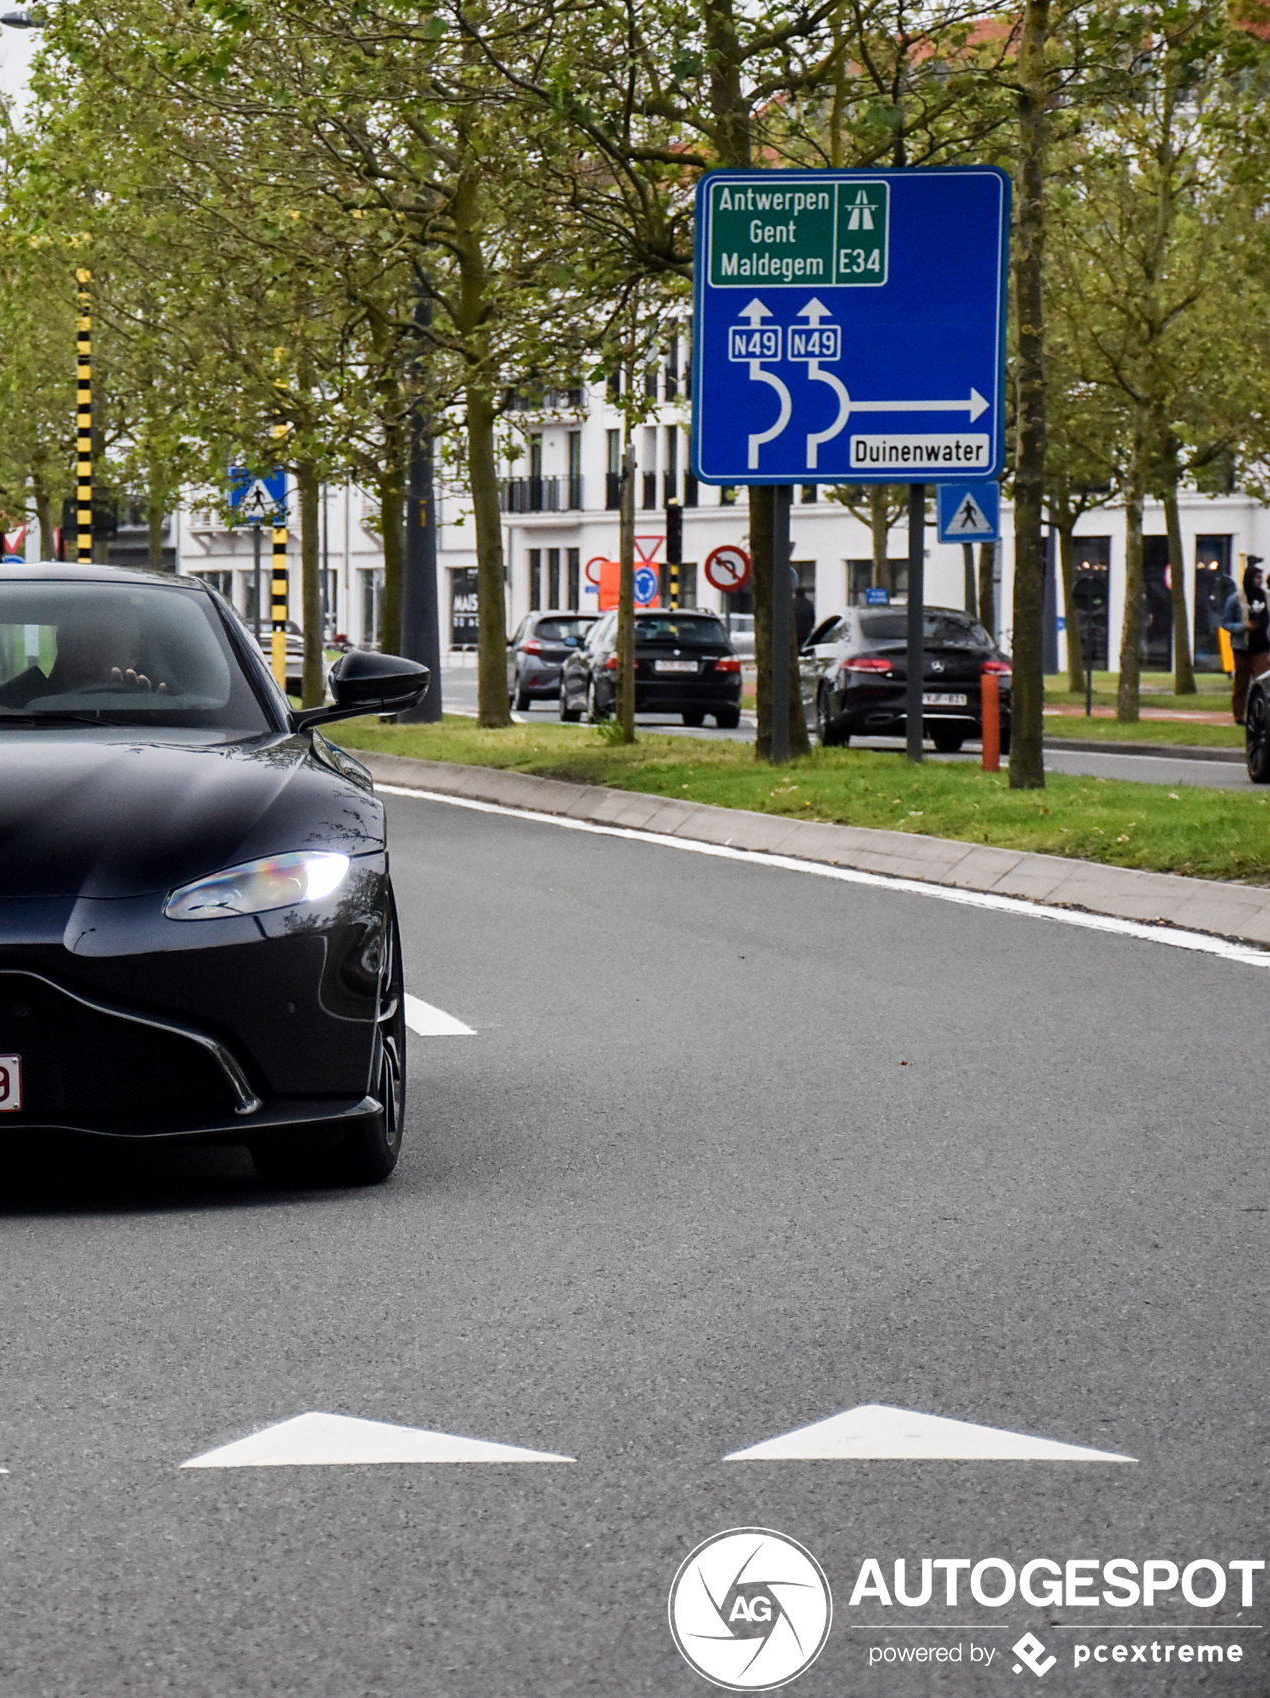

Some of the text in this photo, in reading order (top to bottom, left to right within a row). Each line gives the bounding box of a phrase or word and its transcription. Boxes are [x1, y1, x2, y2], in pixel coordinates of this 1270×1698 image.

[719, 187, 829, 216] Antwerpen
[749, 219, 797, 243] Gent
[721, 252, 824, 282] Maldegem
[839, 249, 881, 273] E34
[734, 332, 776, 356] N49
[793, 331, 835, 355] N49
[855, 440, 984, 463] Duinenwater
